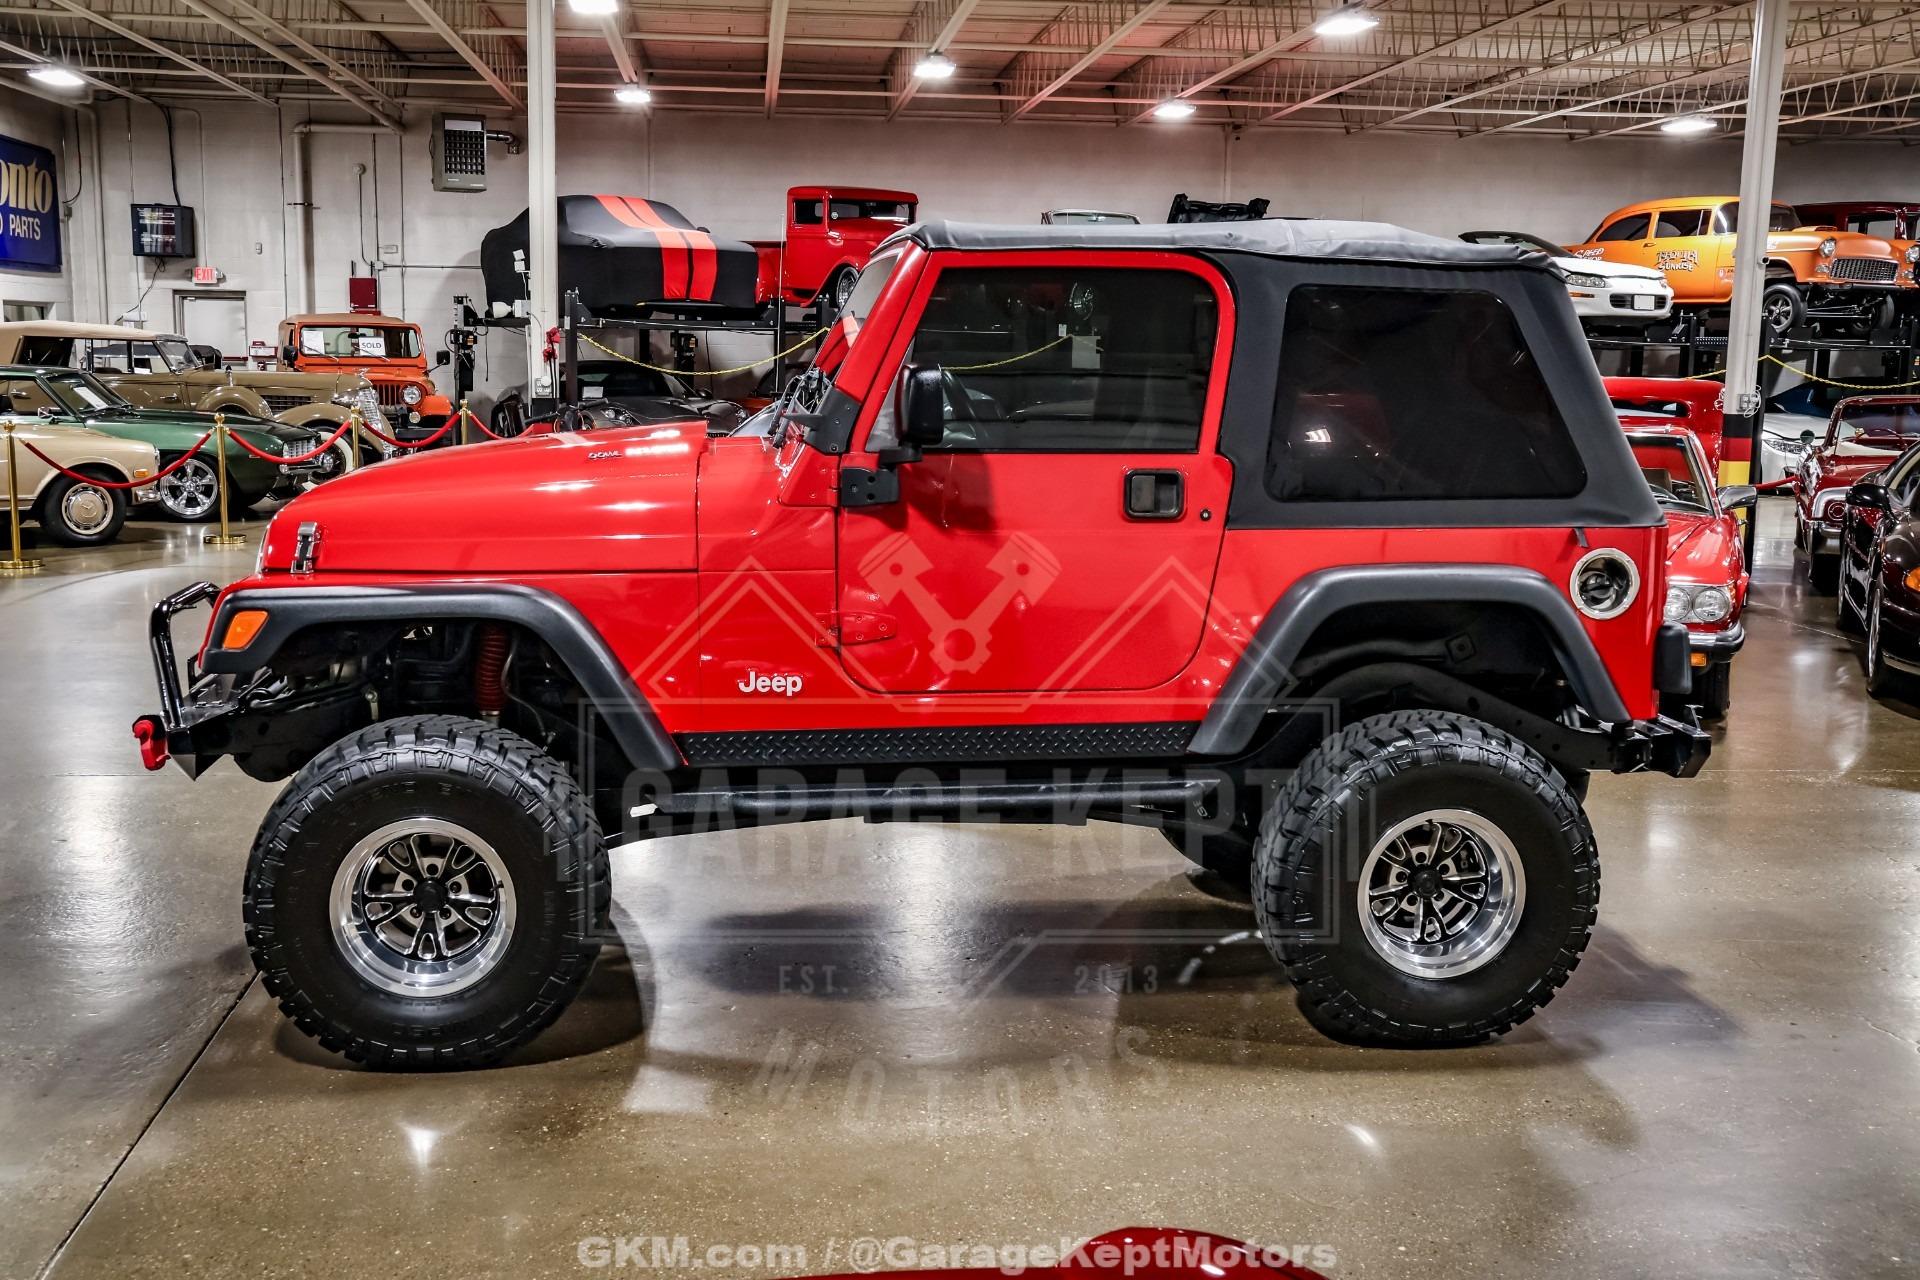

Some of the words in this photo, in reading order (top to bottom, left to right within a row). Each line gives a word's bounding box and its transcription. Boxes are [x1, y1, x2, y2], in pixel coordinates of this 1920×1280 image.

[9, 213, 41, 240] PARTS
[195, 268, 214, 281] EXIT
[738, 671, 803, 697] Jeep
